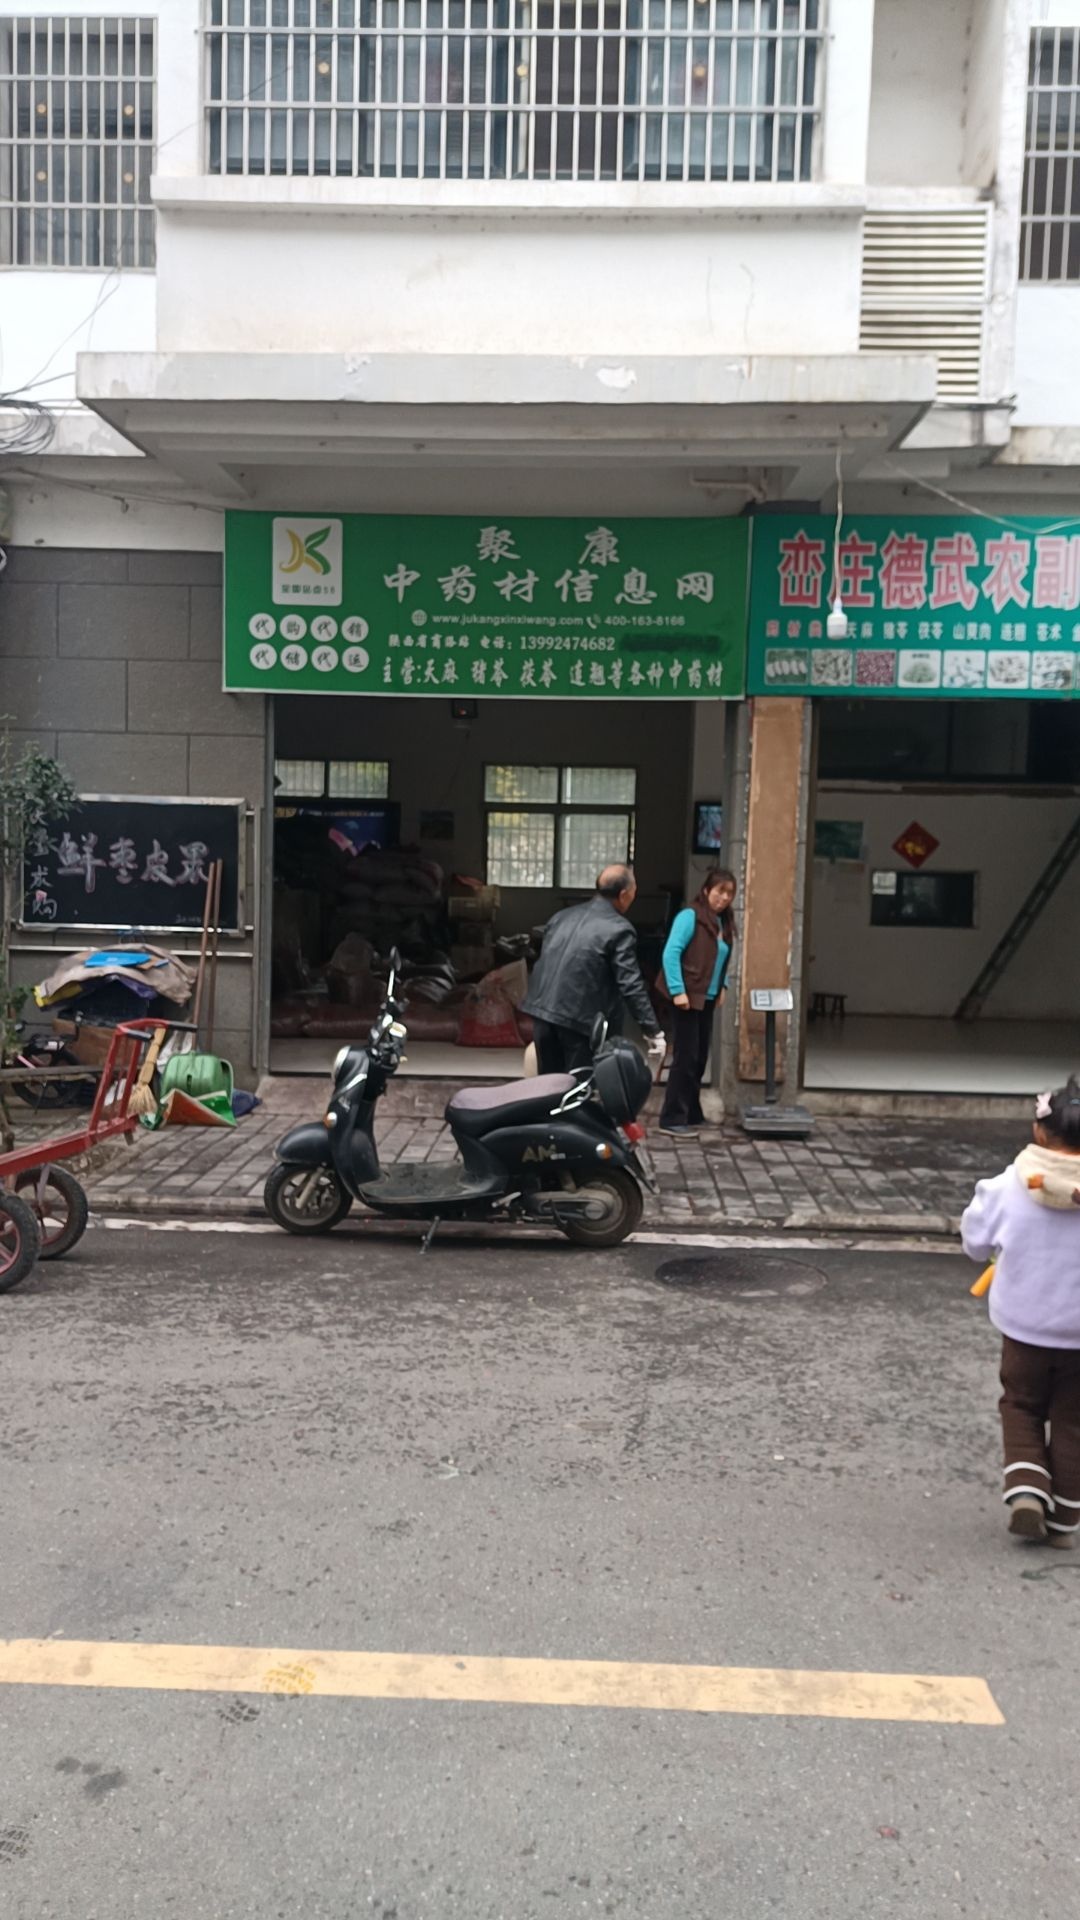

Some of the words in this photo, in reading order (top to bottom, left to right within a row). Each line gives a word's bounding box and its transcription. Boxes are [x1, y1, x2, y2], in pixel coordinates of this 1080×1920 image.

[384, 563, 715, 605] 中药材信息网
[778, 528, 1080, 613] 峦庄德武农副
[431, 614, 584, 628] www.jukangxinxiwang.com
[520, 636, 616, 651] 13992474682
